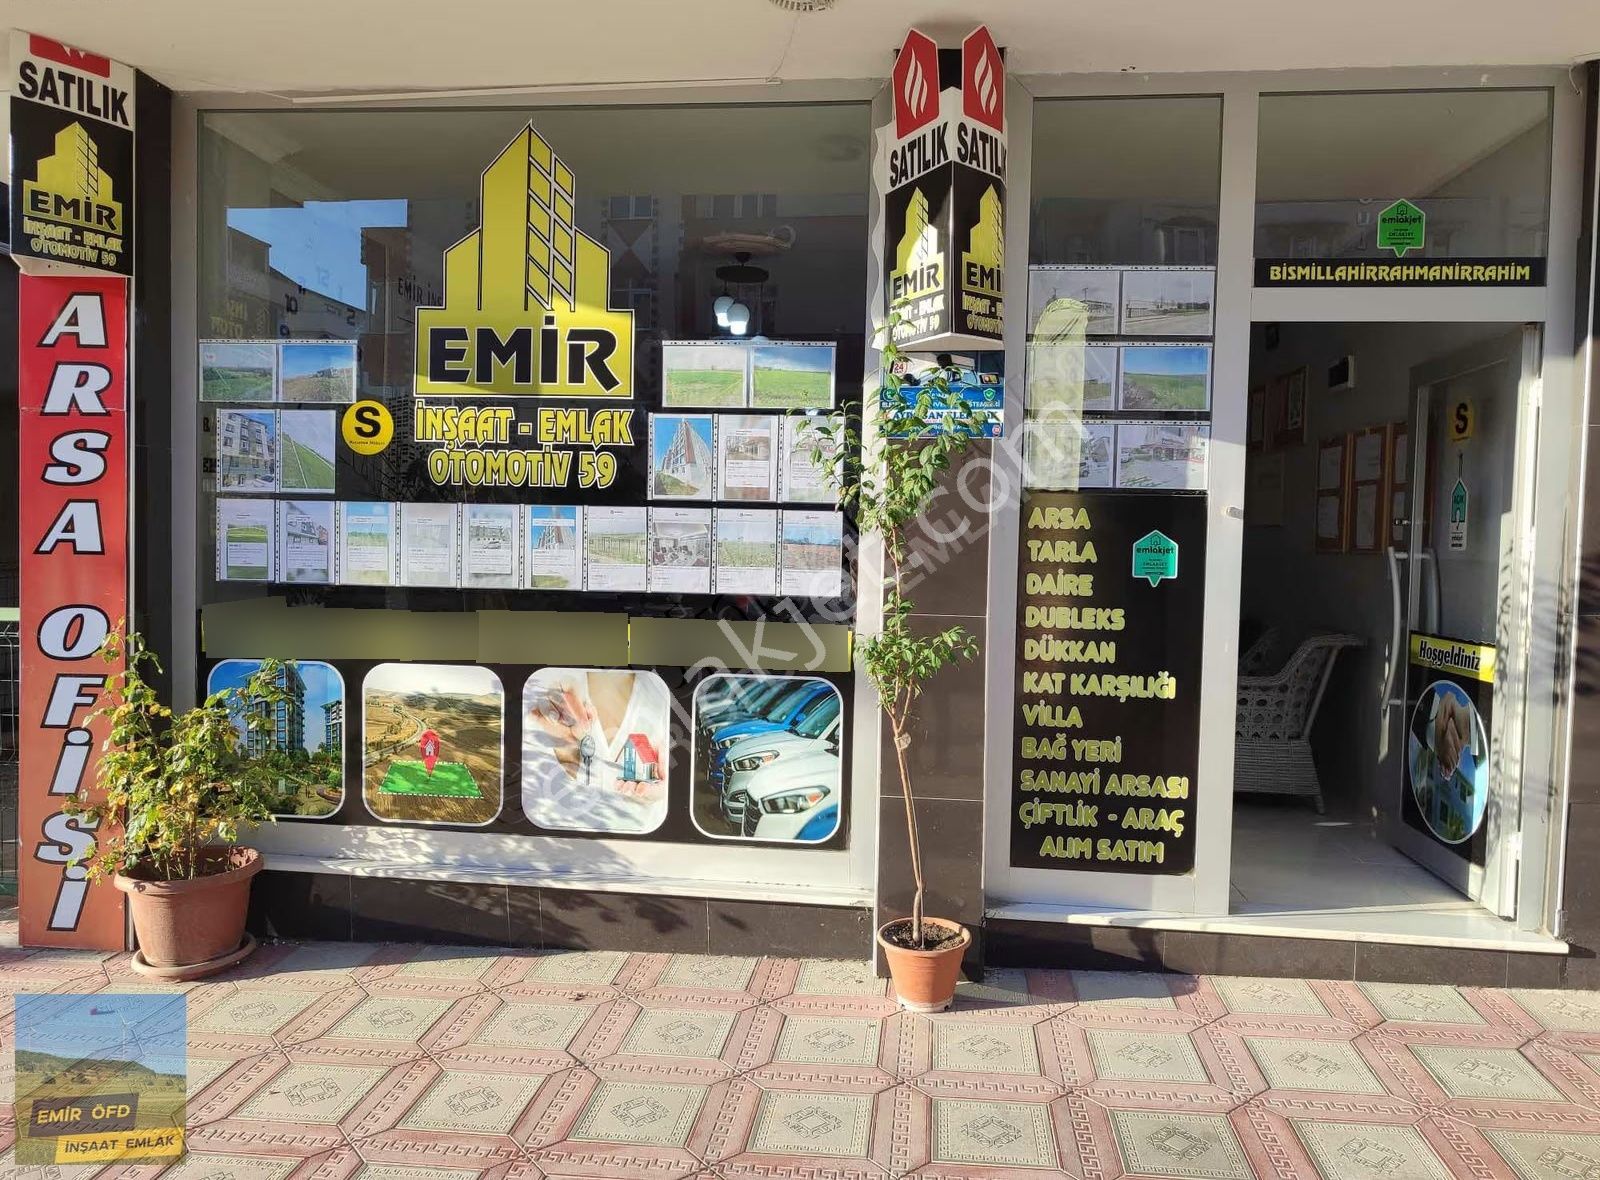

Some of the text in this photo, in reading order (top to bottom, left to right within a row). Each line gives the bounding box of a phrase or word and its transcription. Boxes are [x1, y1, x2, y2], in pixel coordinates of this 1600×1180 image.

[19, 61, 129, 126] SATILIK
[890, 121, 949, 188] SATILIK
[31, 189, 117, 231] EMİR
[101, 251, 117, 266] 59
[1269, 263, 1530, 282] BİSMİLLAHİRRAHMANİRRAHİM
[893, 262, 940, 300] EMİR
[428, 313, 622, 394] EMİR
[354, 406, 381, 438] S
[414, 399, 513, 450] İNŞAAT
[537, 407, 634, 449] EMLAK
[428, 446, 617, 488] OTOMOTİV 59
[1027, 507, 1092, 530] ARSA
[1027, 540, 1098, 564] TARLA
[1025, 569, 1094, 597] DAİRE
[1025, 605, 1126, 631] DUBLEKS
[1024, 634, 1116, 664] DÜKKAN
[1419, 639, 1481, 671] Hoşgeldiniz
[1023, 671, 1177, 703] KAT KARŞILIĞI
[1022, 700, 1084, 728] VİLLA
[1021, 733, 1122, 763] BAĞ YERİ
[1020, 767, 1189, 800] SANAYİ ARSASI
[1019, 797, 1099, 830] ÇİFTLİK
[1121, 806, 1185, 838] ARAÇ
[1039, 835, 1165, 864] ALIM SATIM
